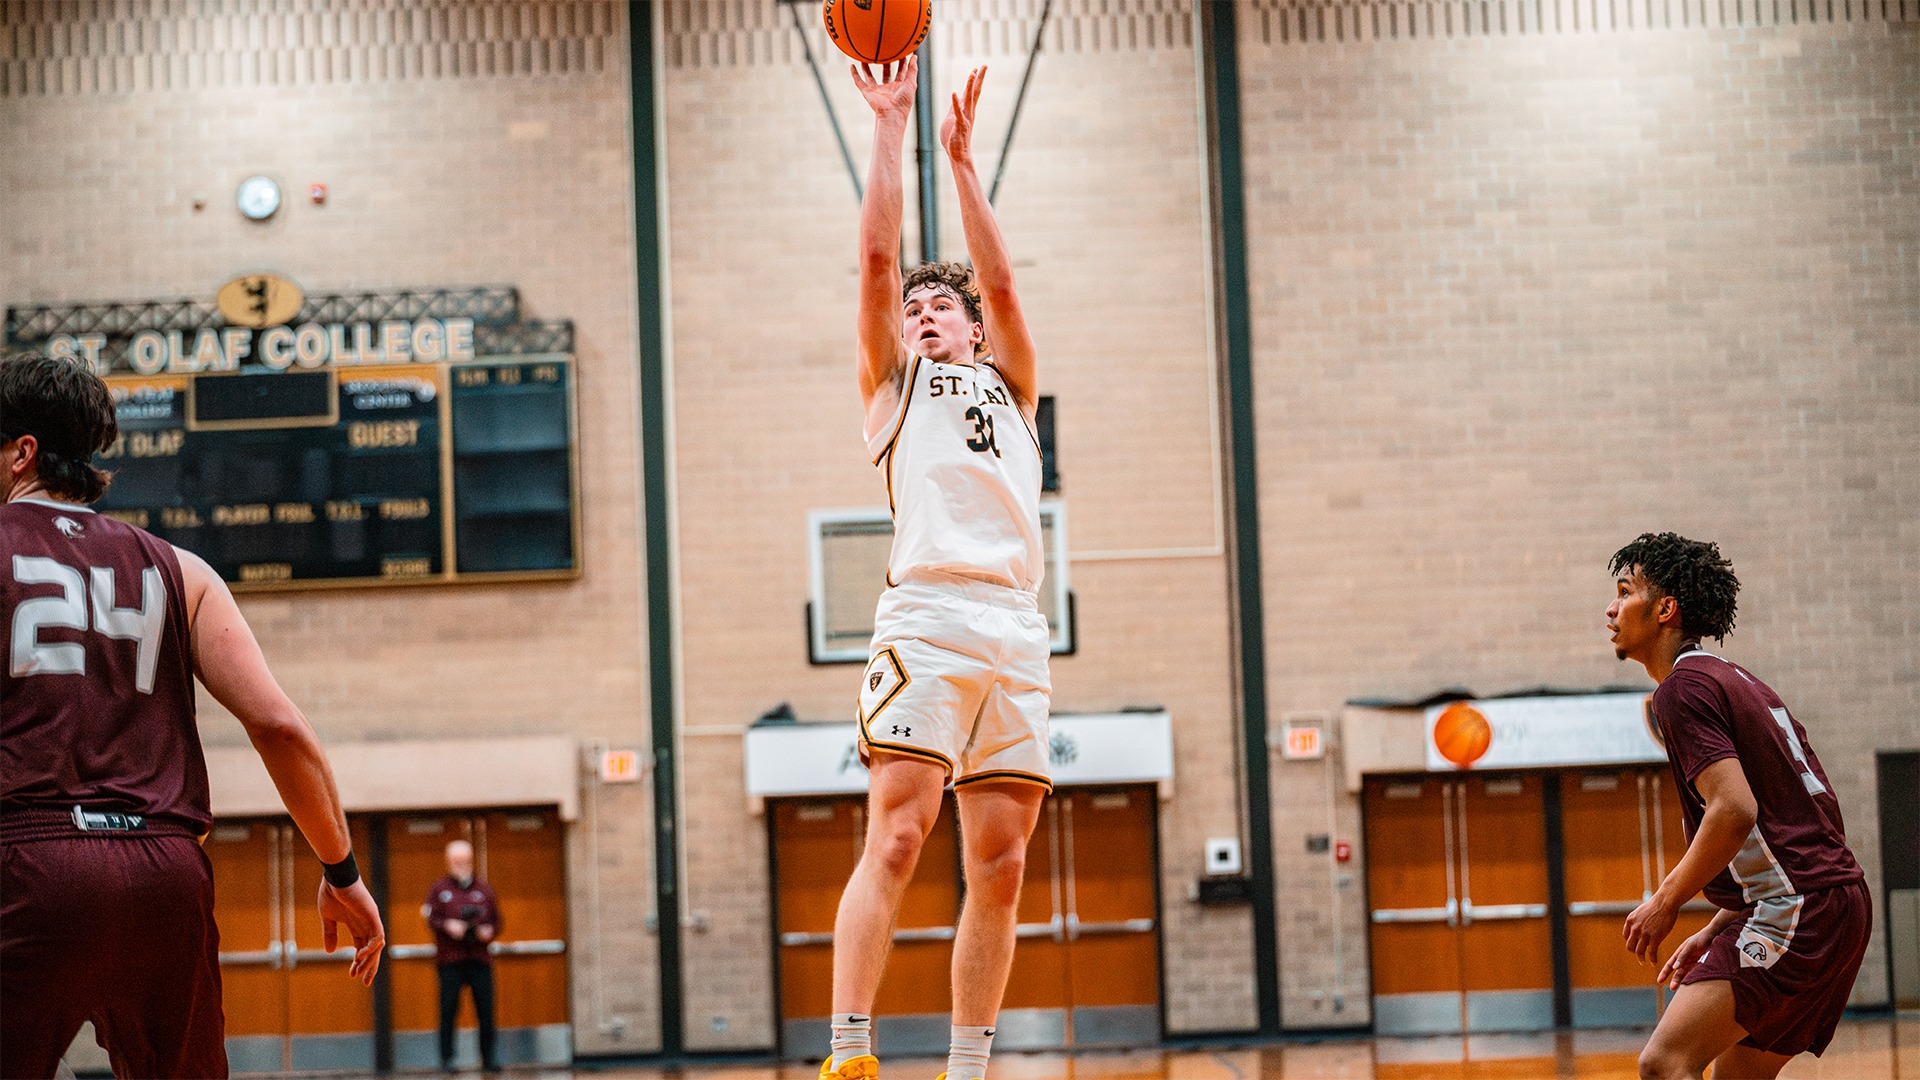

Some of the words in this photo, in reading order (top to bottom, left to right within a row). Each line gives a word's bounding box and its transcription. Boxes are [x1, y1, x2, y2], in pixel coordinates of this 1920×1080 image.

[129, 328, 252, 374] OLAF
[259, 318, 475, 370] COLLEGE
[929, 376, 967, 398] ST.
[347, 420, 420, 449] GUEST
[964, 406, 1002, 459] 31
[9, 555, 168, 694] 24
